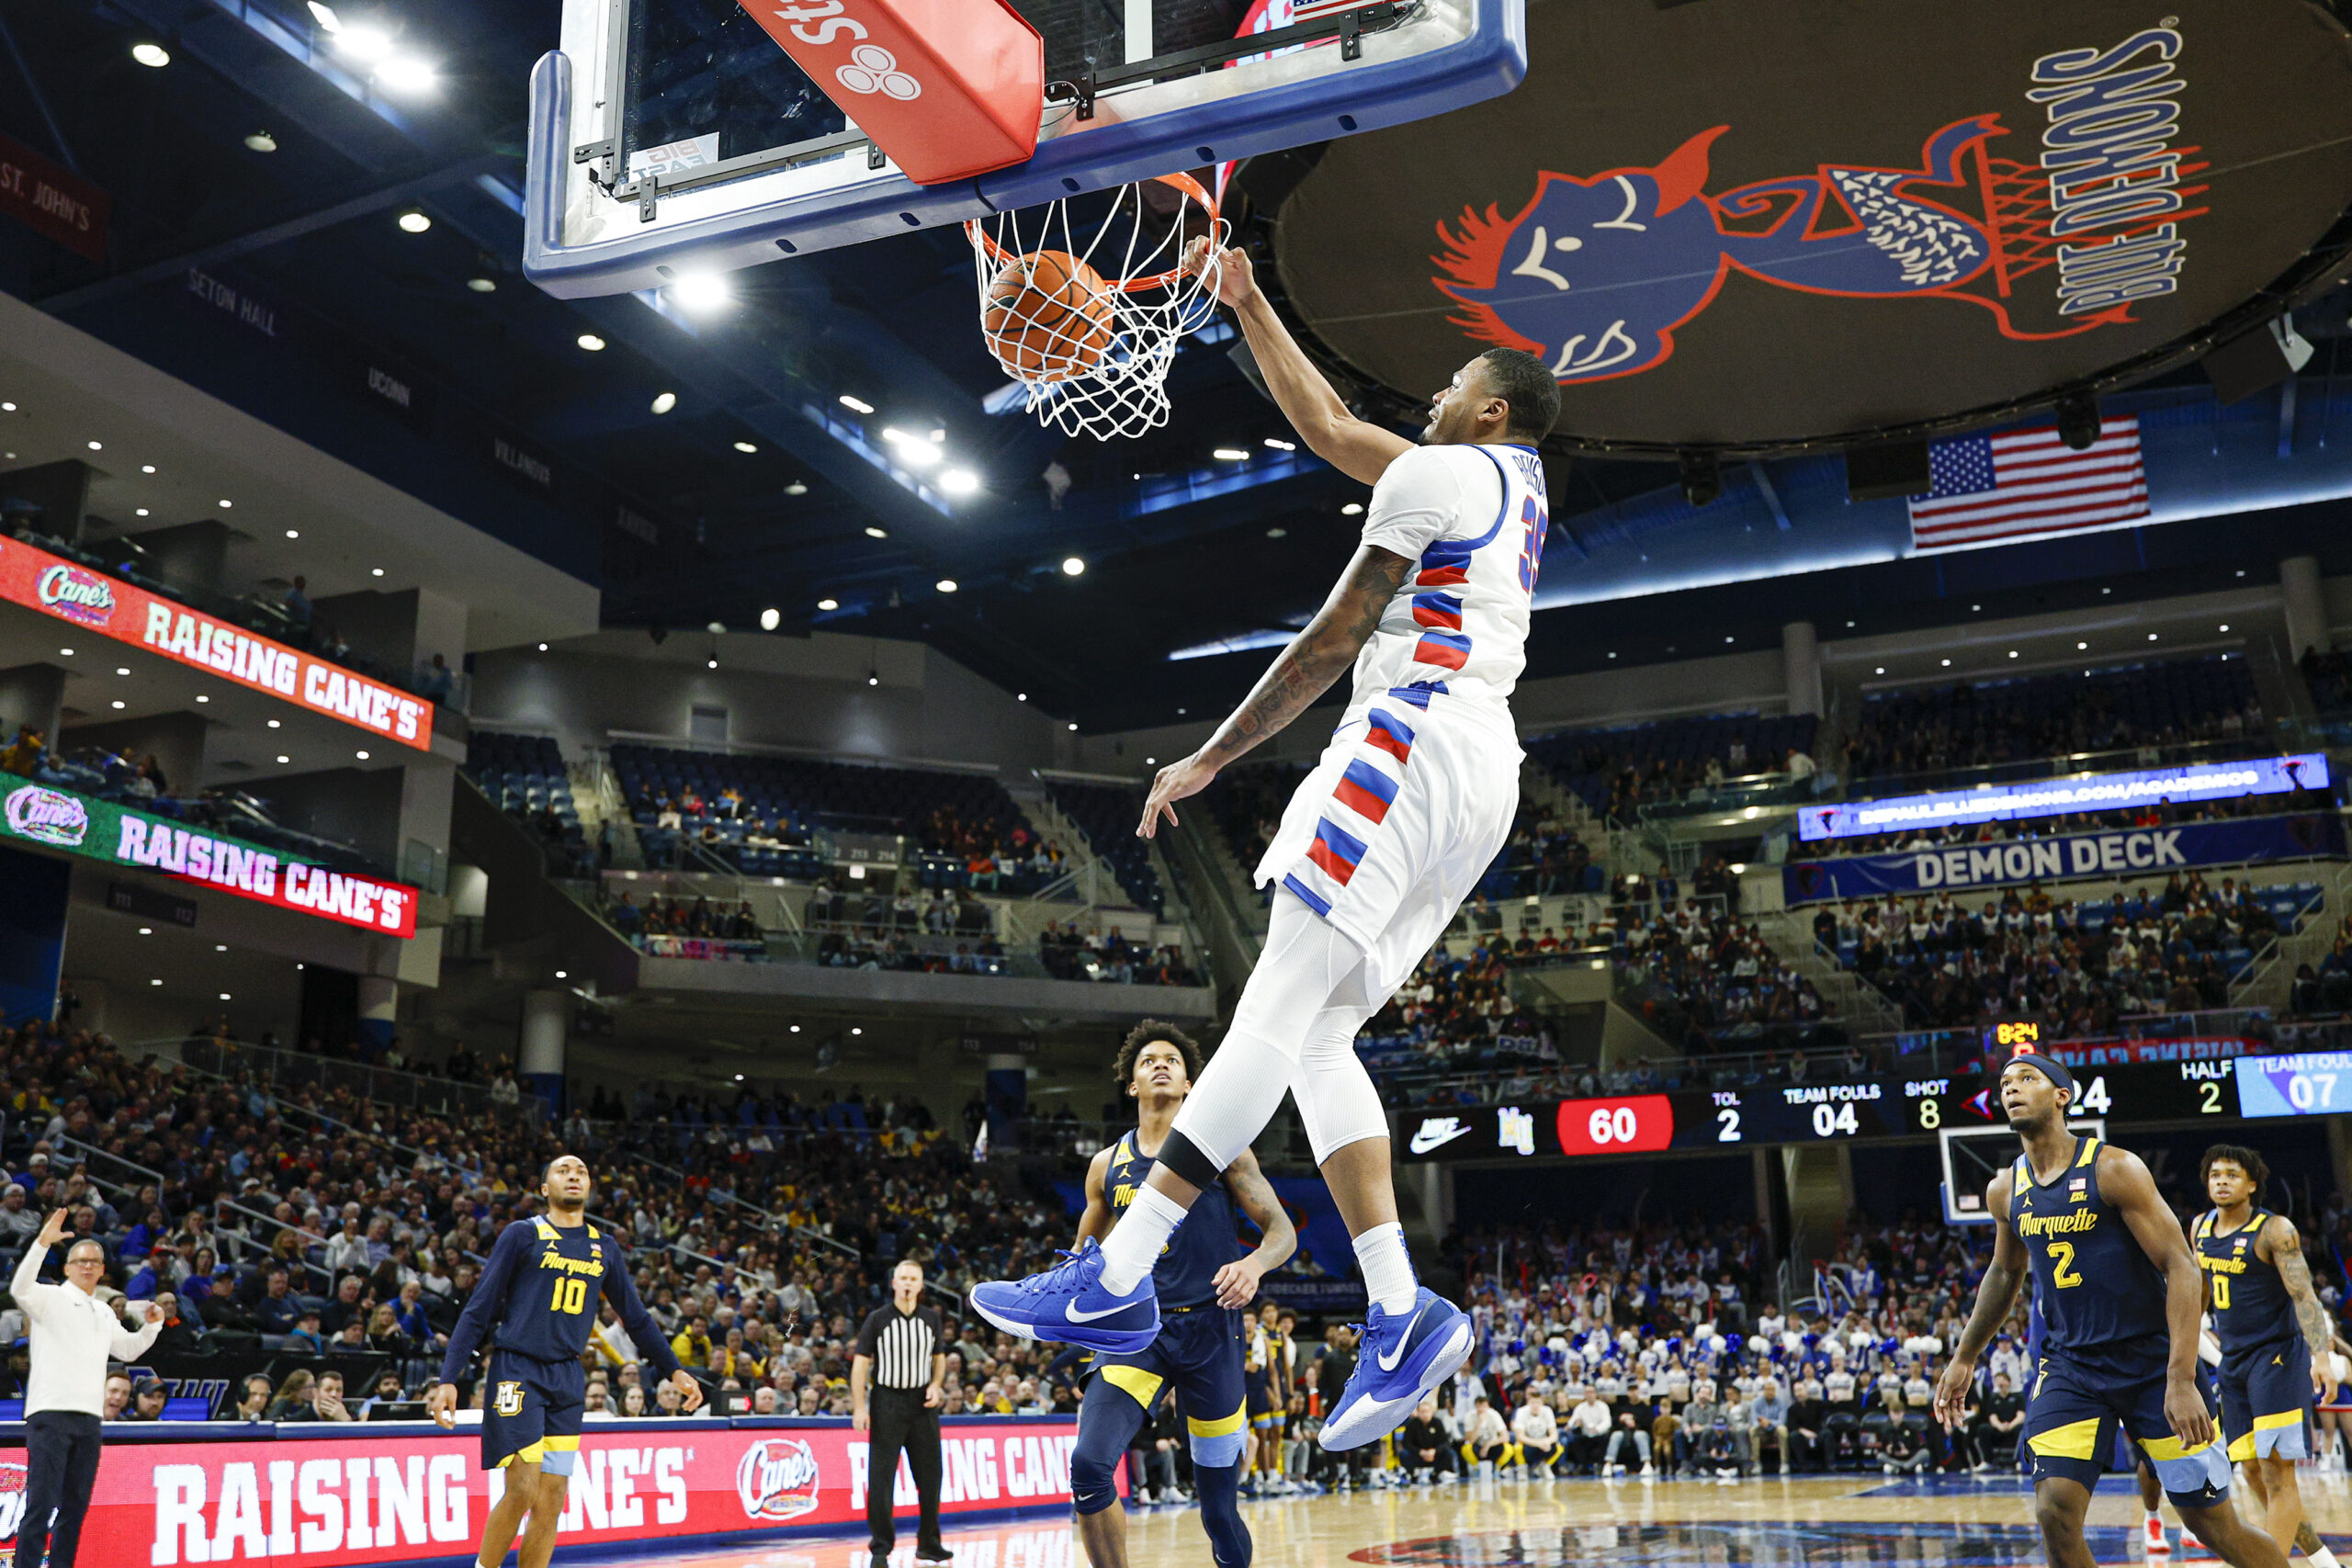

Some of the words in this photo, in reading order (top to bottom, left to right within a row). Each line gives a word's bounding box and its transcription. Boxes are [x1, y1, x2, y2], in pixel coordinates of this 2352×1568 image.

[2025, 28, 2188, 236] DEMONS
[1, 163, 24, 197] ST.
[33, 182, 90, 231] JOHN'S
[2057, 222, 2187, 314] BLUE
[1511, 455, 1548, 499] BENSO
[39, 564, 114, 609] Cane's
[143, 601, 298, 695] RAISING
[304, 664, 419, 739] CANE'S
[117, 814, 277, 897] RAISING
[285, 862, 401, 929] CANE'S
[1916, 841, 2063, 887] DEMON
[2070, 829, 2188, 874] DECK
[1996, 1021, 2039, 1045] 8:24
[2181, 1059, 2233, 1080] HALF
[2255, 1055, 2304, 1074] TEAM
[2307, 1053, 2352, 1071] FOUL
[1712, 1091, 1741, 1107] TOL
[1783, 1087, 1828, 1104] TEAM
[1828, 1084, 1882, 1101] FOULS
[1905, 1079, 1949, 1098] SHOT
[2199, 1081, 2222, 1113] 2
[2289, 1073, 2337, 1110] 07
[1419, 1116, 1460, 1139] NIKE
[1589, 1107, 1637, 1145] 60
[1717, 1109, 1742, 1142] 2
[1813, 1102, 1860, 1137] 04
[1919, 1099, 1940, 1130] 8
[2018, 1207, 2098, 1240] Marquette
[539, 1251, 605, 1277] Marquette
[2046, 1241, 2084, 1290] 2
[550, 1276, 587, 1315] 10
[2211, 1273, 2231, 1310] 0
[493, 1381, 525, 1416] MU
[741, 1439, 818, 1516] Cane's
[150, 1453, 469, 1566] RAISING
